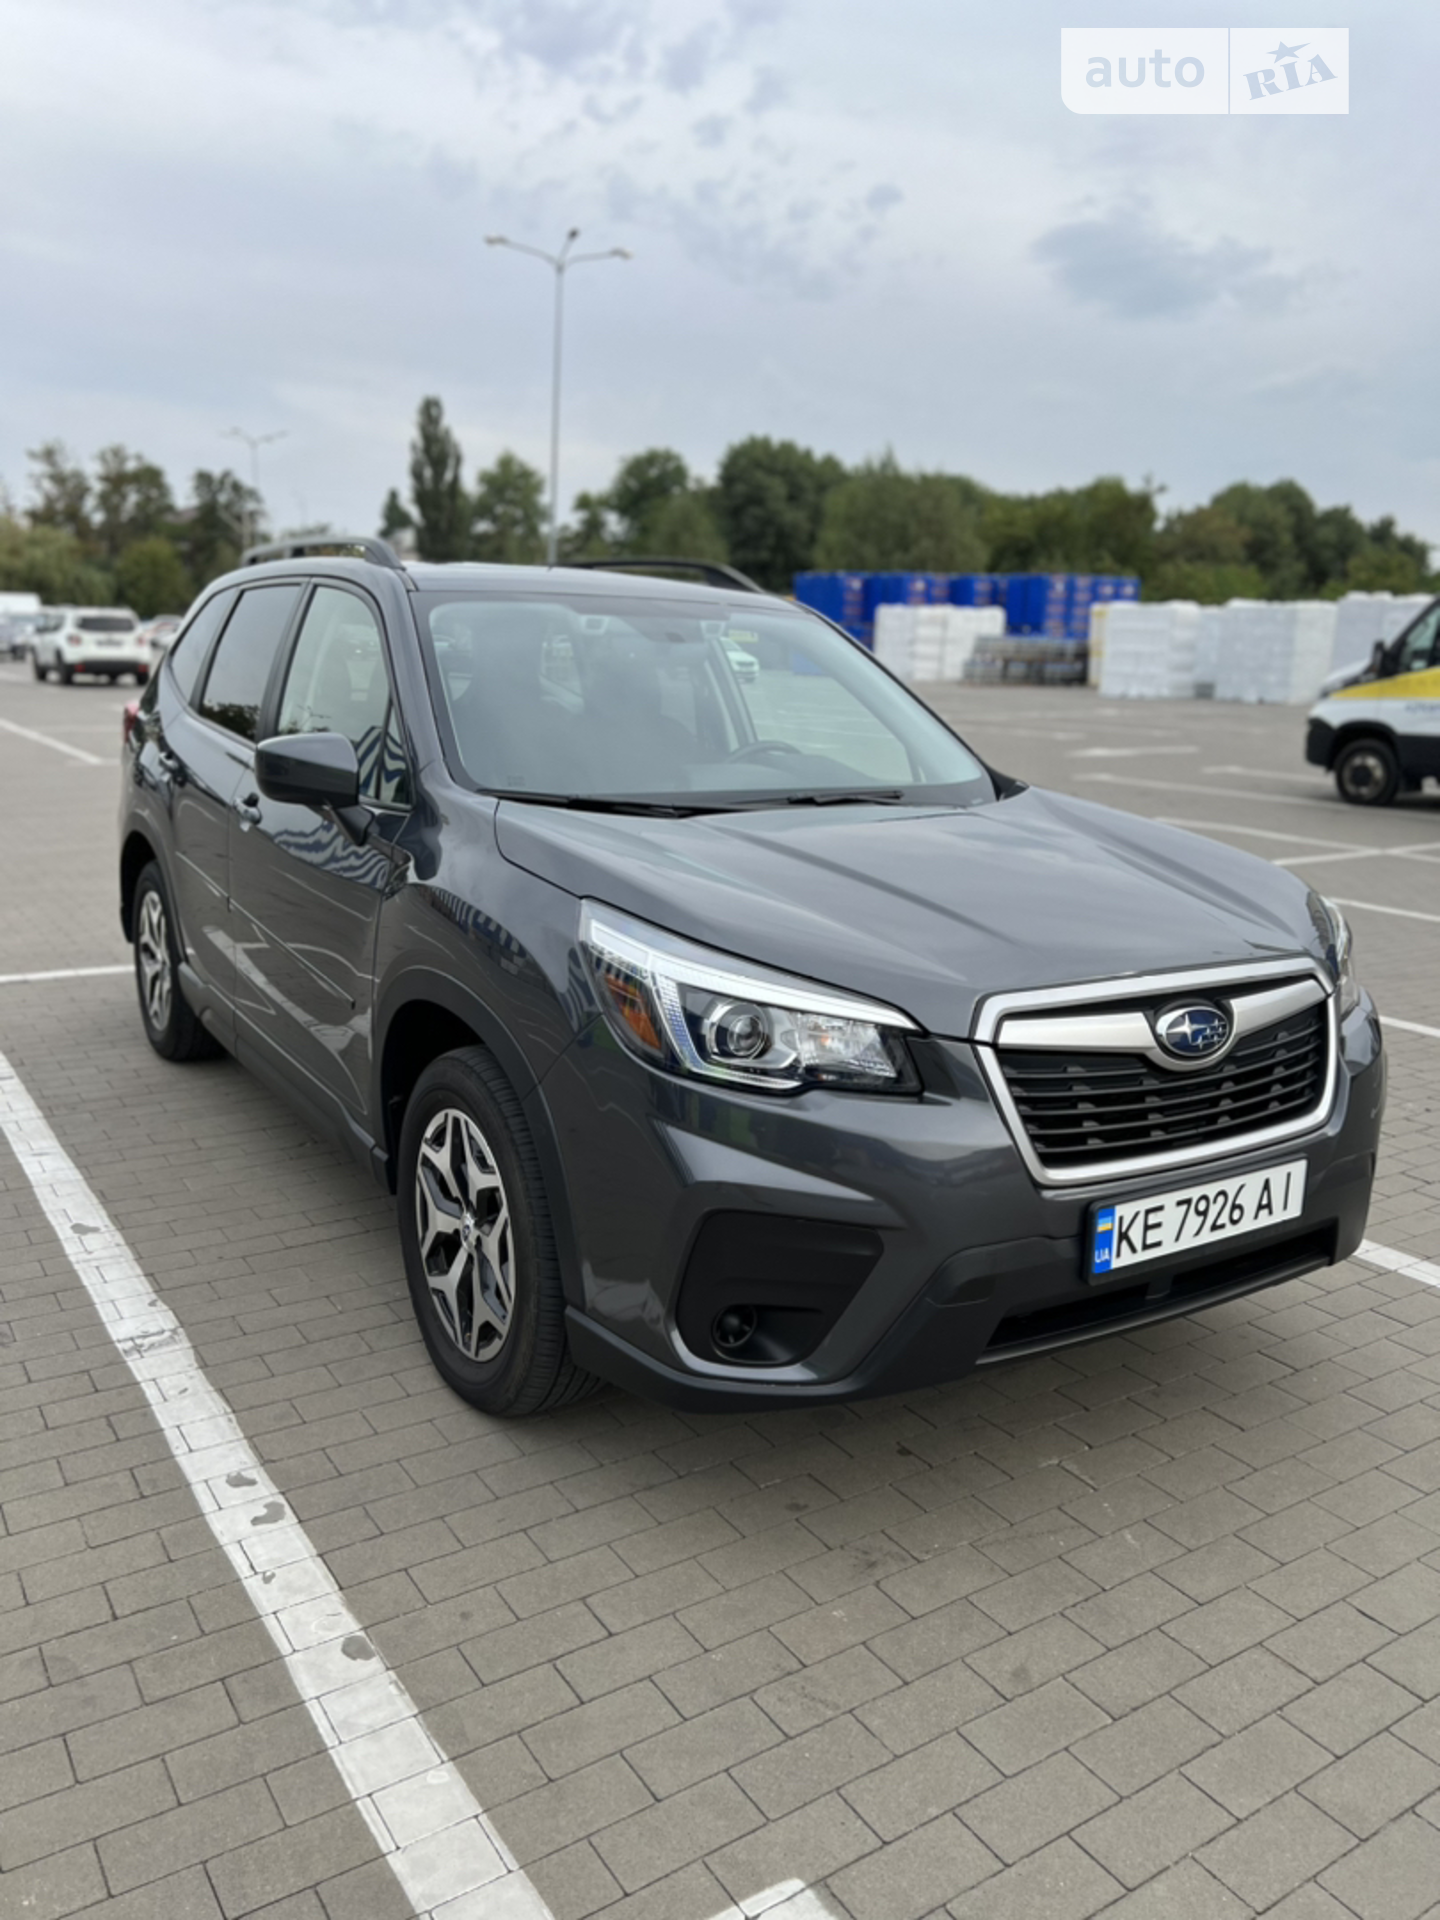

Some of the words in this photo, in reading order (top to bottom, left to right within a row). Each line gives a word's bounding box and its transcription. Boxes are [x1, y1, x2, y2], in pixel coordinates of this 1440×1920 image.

[1115, 1204, 1165, 1259] KE
[1174, 1182, 1246, 1243] 7926
[1253, 1171, 1292, 1221] AI
[1094, 1247, 1111, 1263] UA
